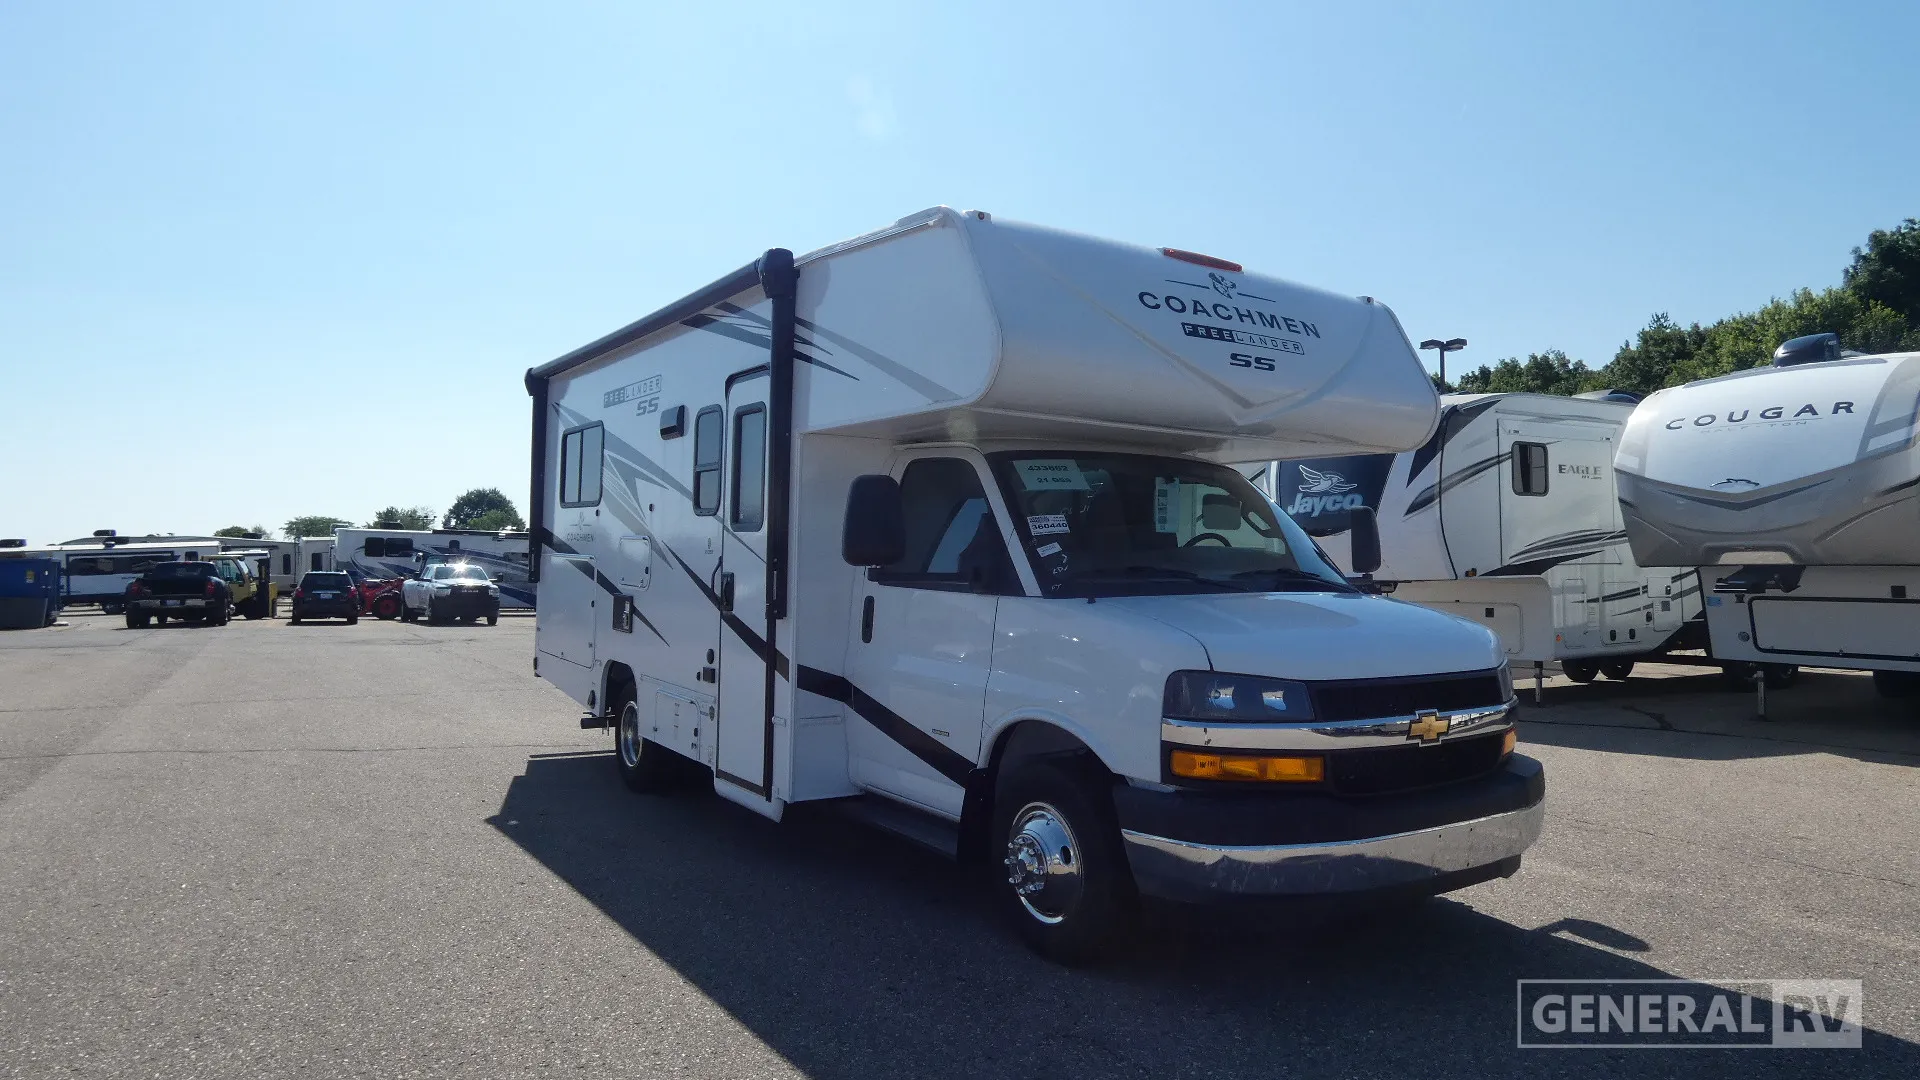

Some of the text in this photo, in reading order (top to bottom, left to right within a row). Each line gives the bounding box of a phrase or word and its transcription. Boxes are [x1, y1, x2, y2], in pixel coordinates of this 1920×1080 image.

[1138, 291, 1321, 339] COACHMEN
[1183, 324, 1302, 353] FREELANDER
[1229, 352, 1276, 372] SS
[635, 396, 660, 416] SS
[1665, 401, 1855, 431] COUGAR
[1287, 492, 1364, 518] Jayco
